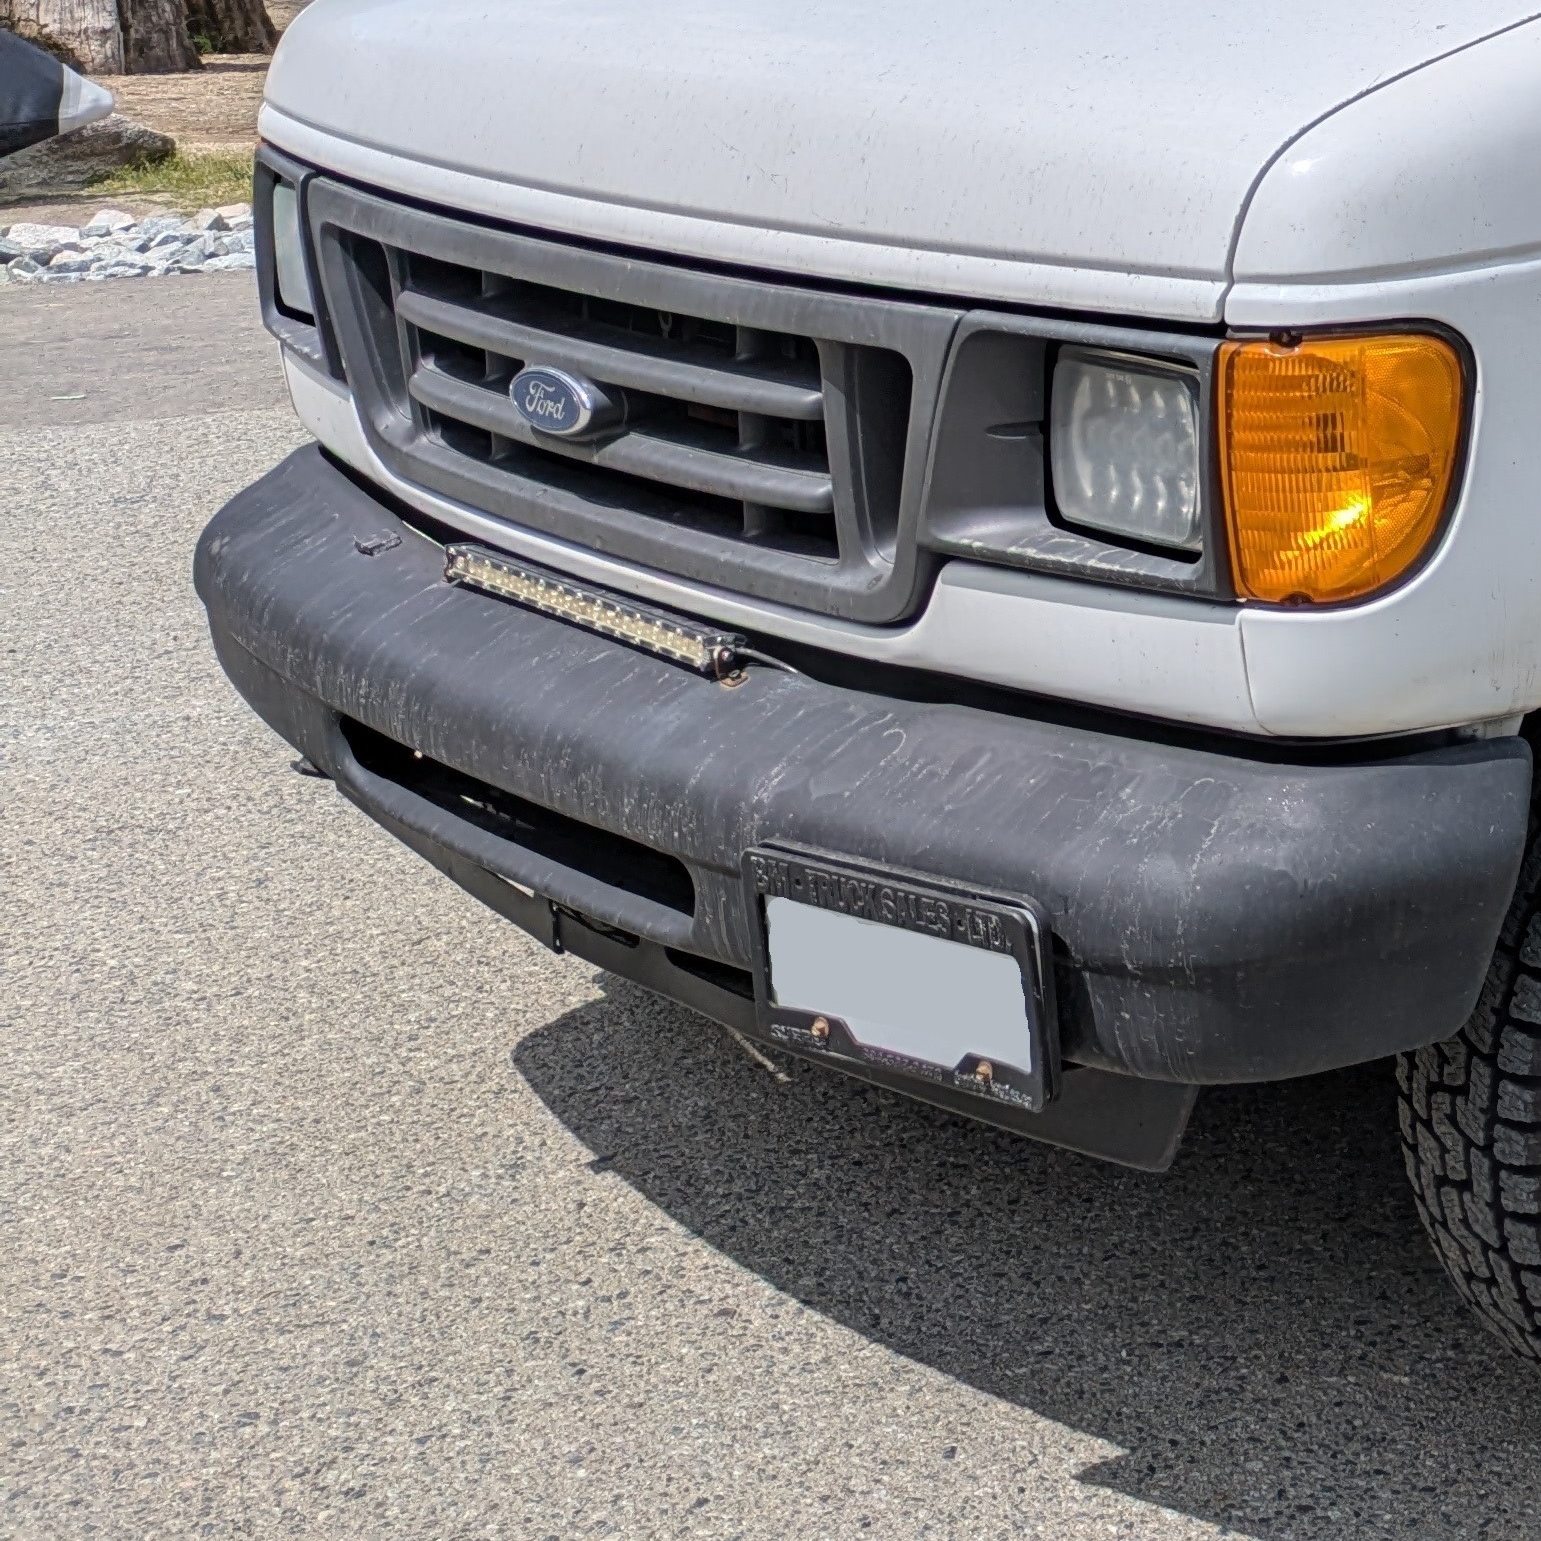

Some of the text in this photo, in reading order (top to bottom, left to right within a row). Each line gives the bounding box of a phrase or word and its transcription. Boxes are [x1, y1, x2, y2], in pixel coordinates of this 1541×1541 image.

[525, 380, 567, 420] Ford
[804, 868, 878, 922] TRUCK
[880, 886, 951, 936] SALES
